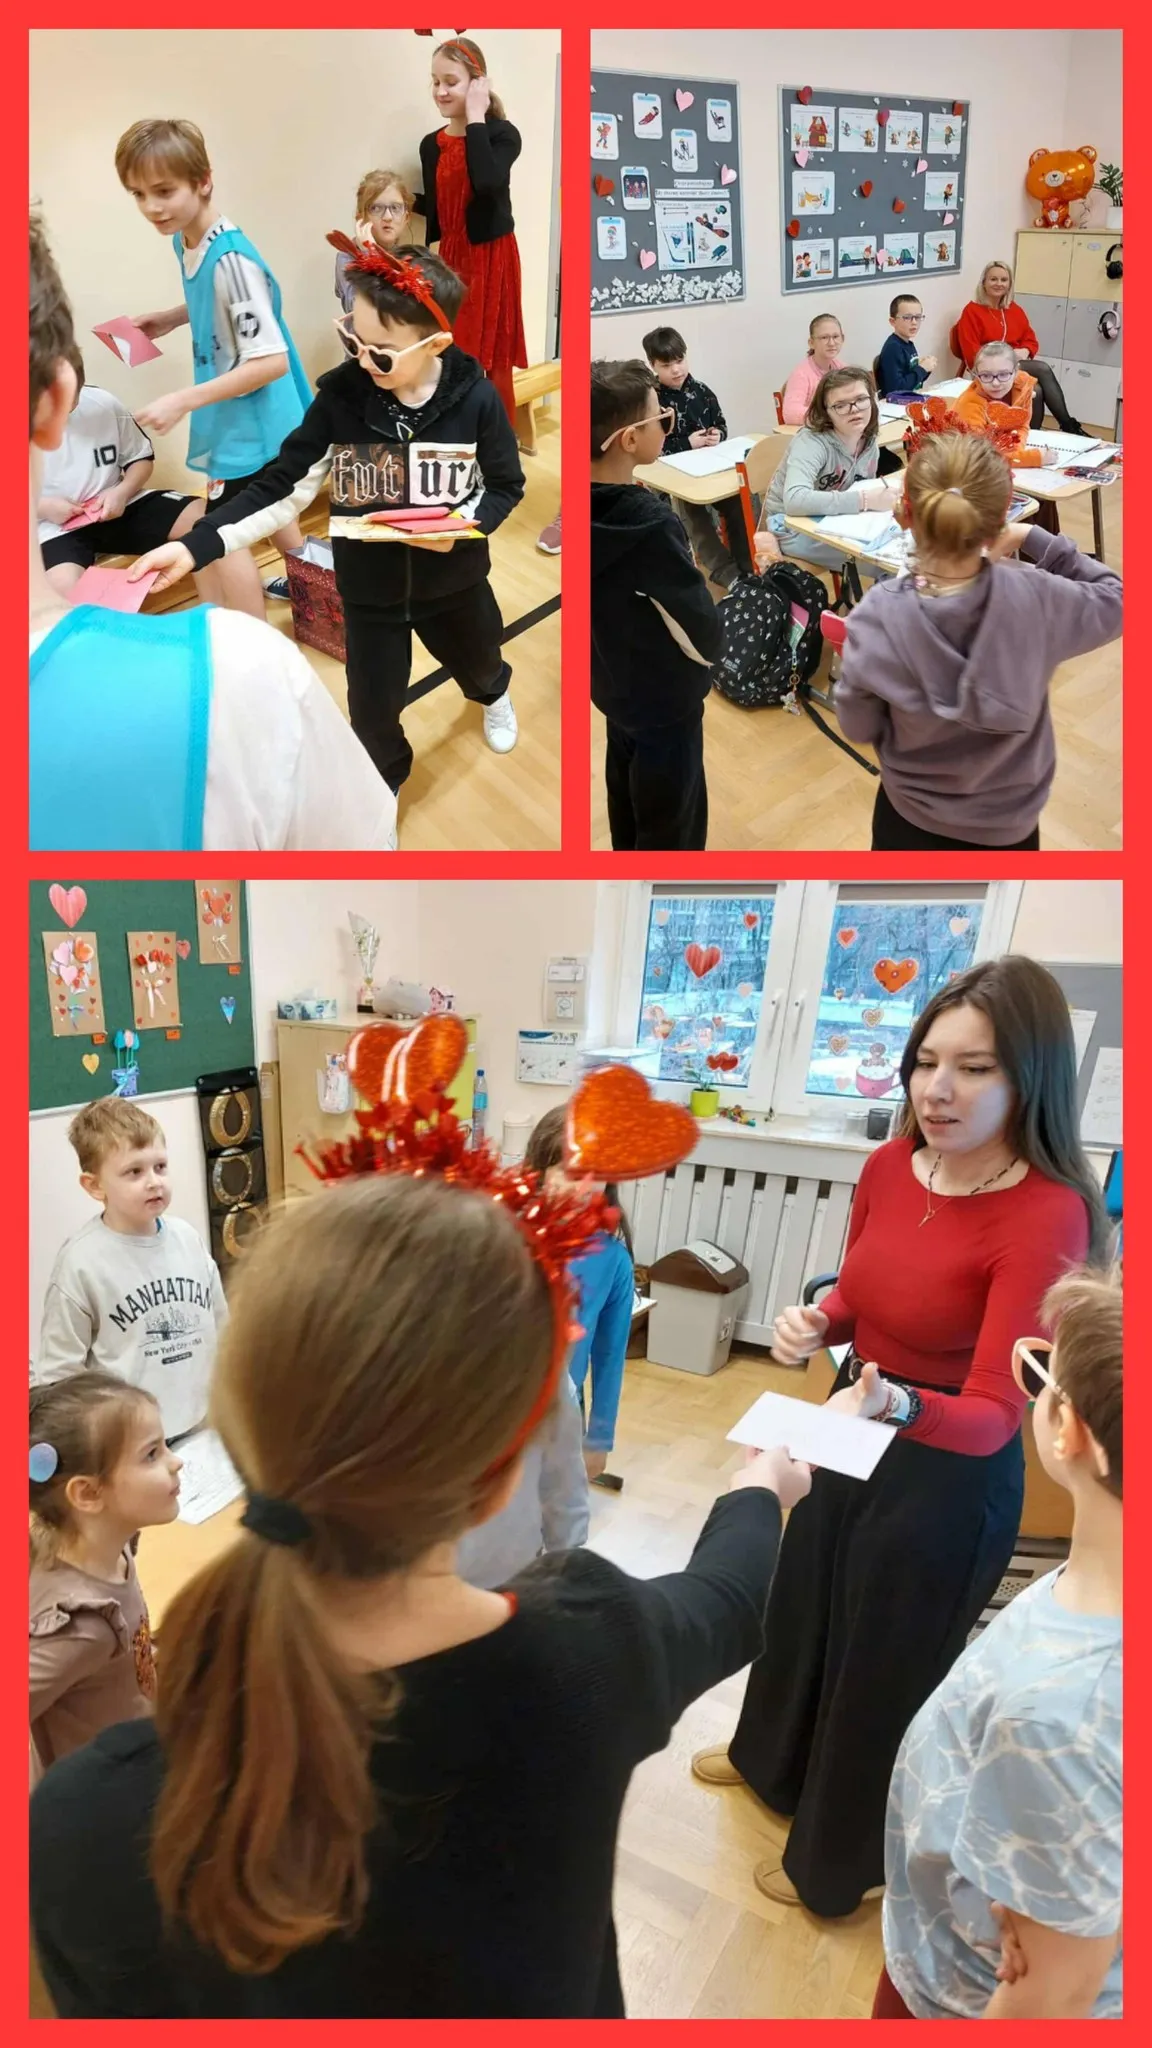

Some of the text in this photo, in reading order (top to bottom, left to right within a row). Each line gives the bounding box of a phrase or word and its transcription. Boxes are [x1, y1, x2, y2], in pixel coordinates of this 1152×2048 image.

[93, 445, 117, 467] 10
[109, 1278, 211, 1332] MANHATTAN
[144, 1348, 160, 1357] New
[161, 1344, 176, 1354] York
